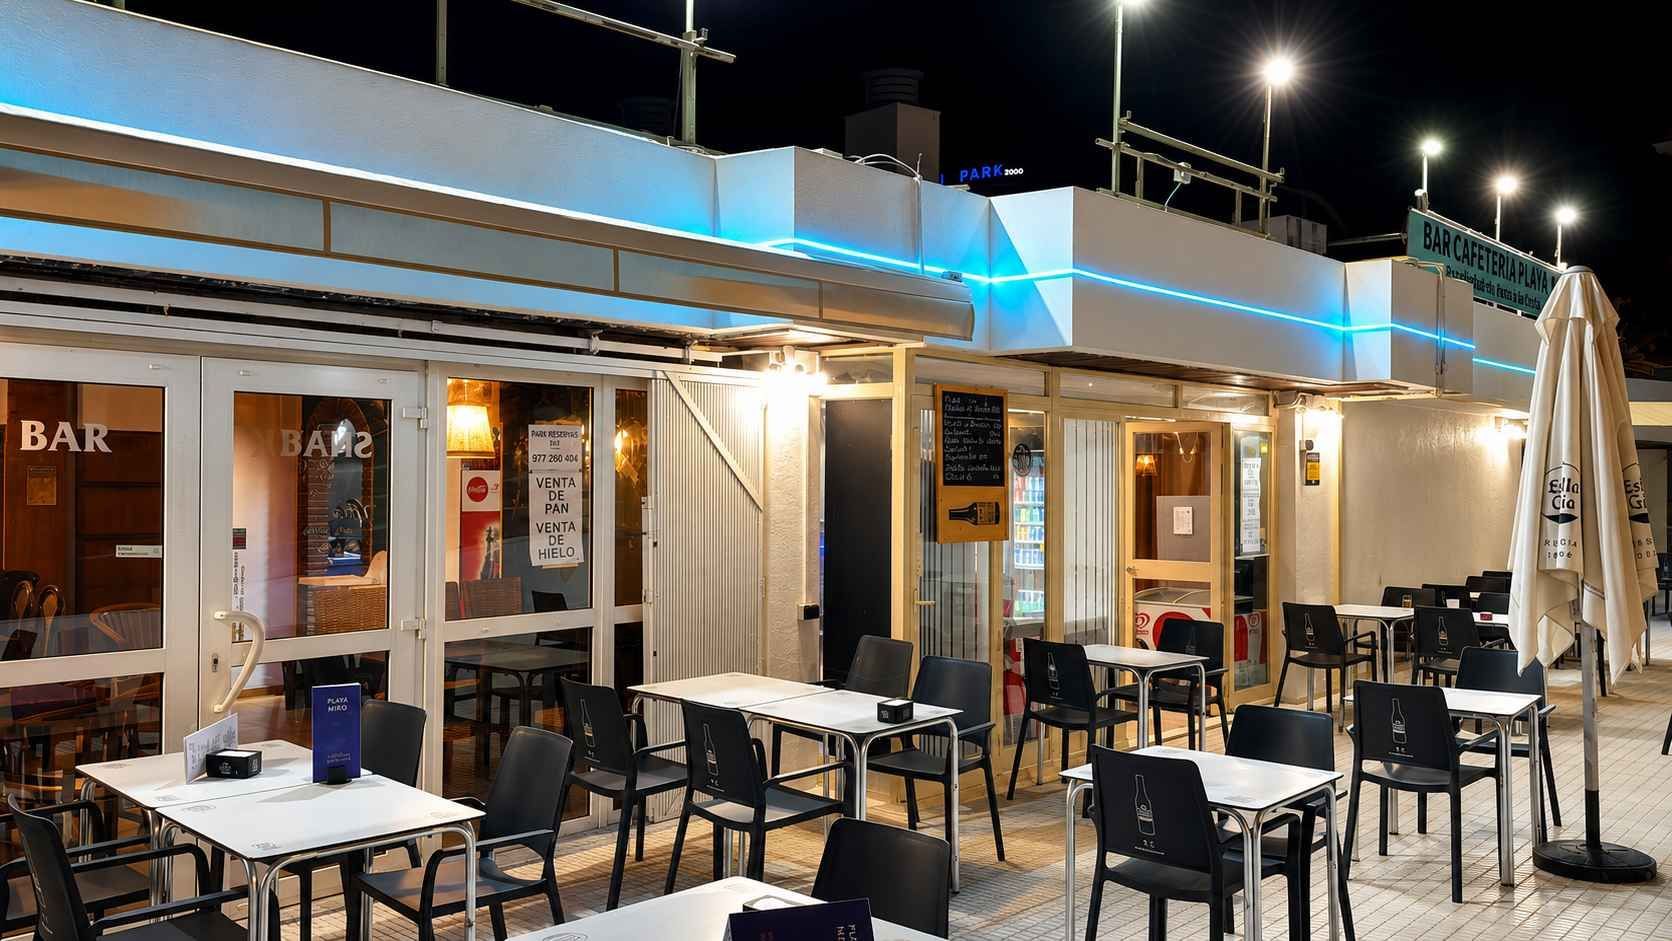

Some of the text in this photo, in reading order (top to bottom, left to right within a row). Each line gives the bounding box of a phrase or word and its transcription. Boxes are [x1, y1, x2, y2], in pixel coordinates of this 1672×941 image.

[960, 164, 1024, 182] PARK 2000
[1423, 220, 1450, 258] BAR
[1518, 261, 1548, 295] PLAYA
[20, 420, 113, 454] BAR
[532, 454, 546, 463] 977
[536, 477, 576, 489] VENTA
[548, 490, 565, 502] DE
[544, 503, 569, 515] PAN
[536, 521, 576, 533] VENTA
[548, 534, 565, 546] DE
[538, 547, 575, 560] HIELO
[327, 697, 348, 705] PLAYA
